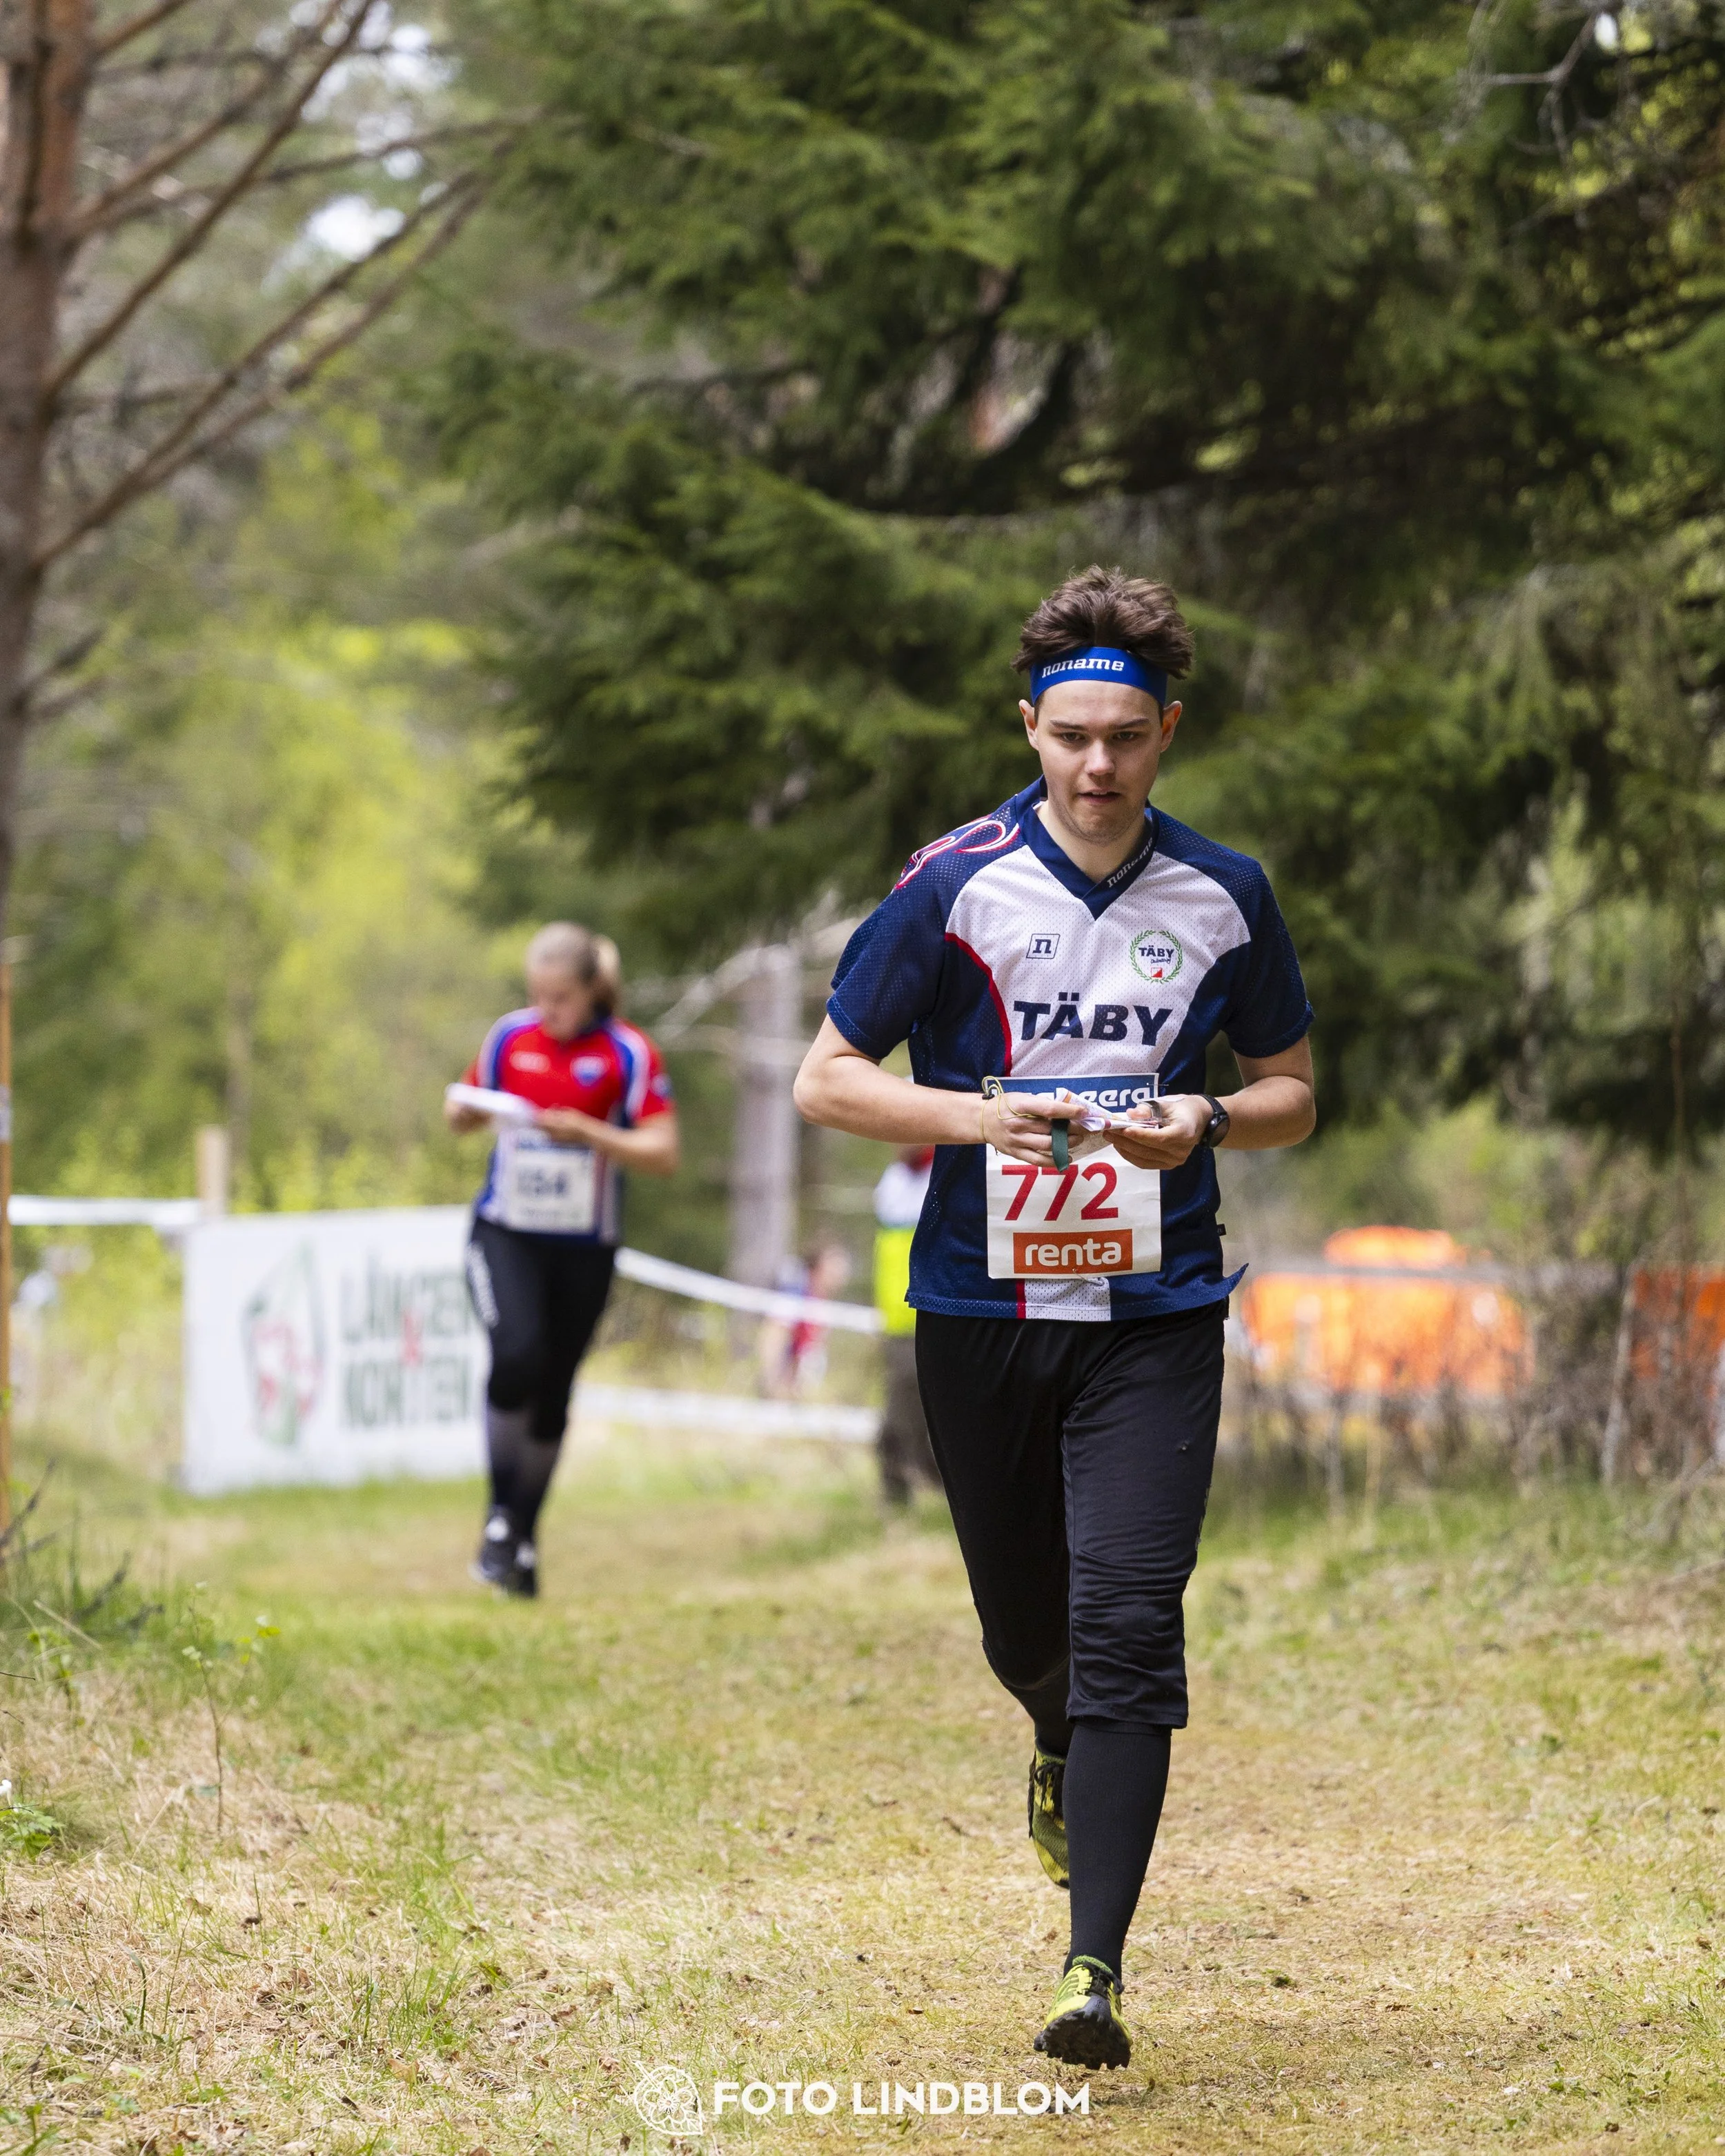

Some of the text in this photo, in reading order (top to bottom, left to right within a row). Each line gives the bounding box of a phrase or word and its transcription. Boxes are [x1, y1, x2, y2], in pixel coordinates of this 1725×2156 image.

[1042, 658, 1125, 678] noname
[1138, 945, 1174, 958] TÄBY
[1014, 991, 1173, 1046] TÄBY
[1002, 1162, 1118, 1221] 772
[1025, 1238, 1122, 1267] renta
